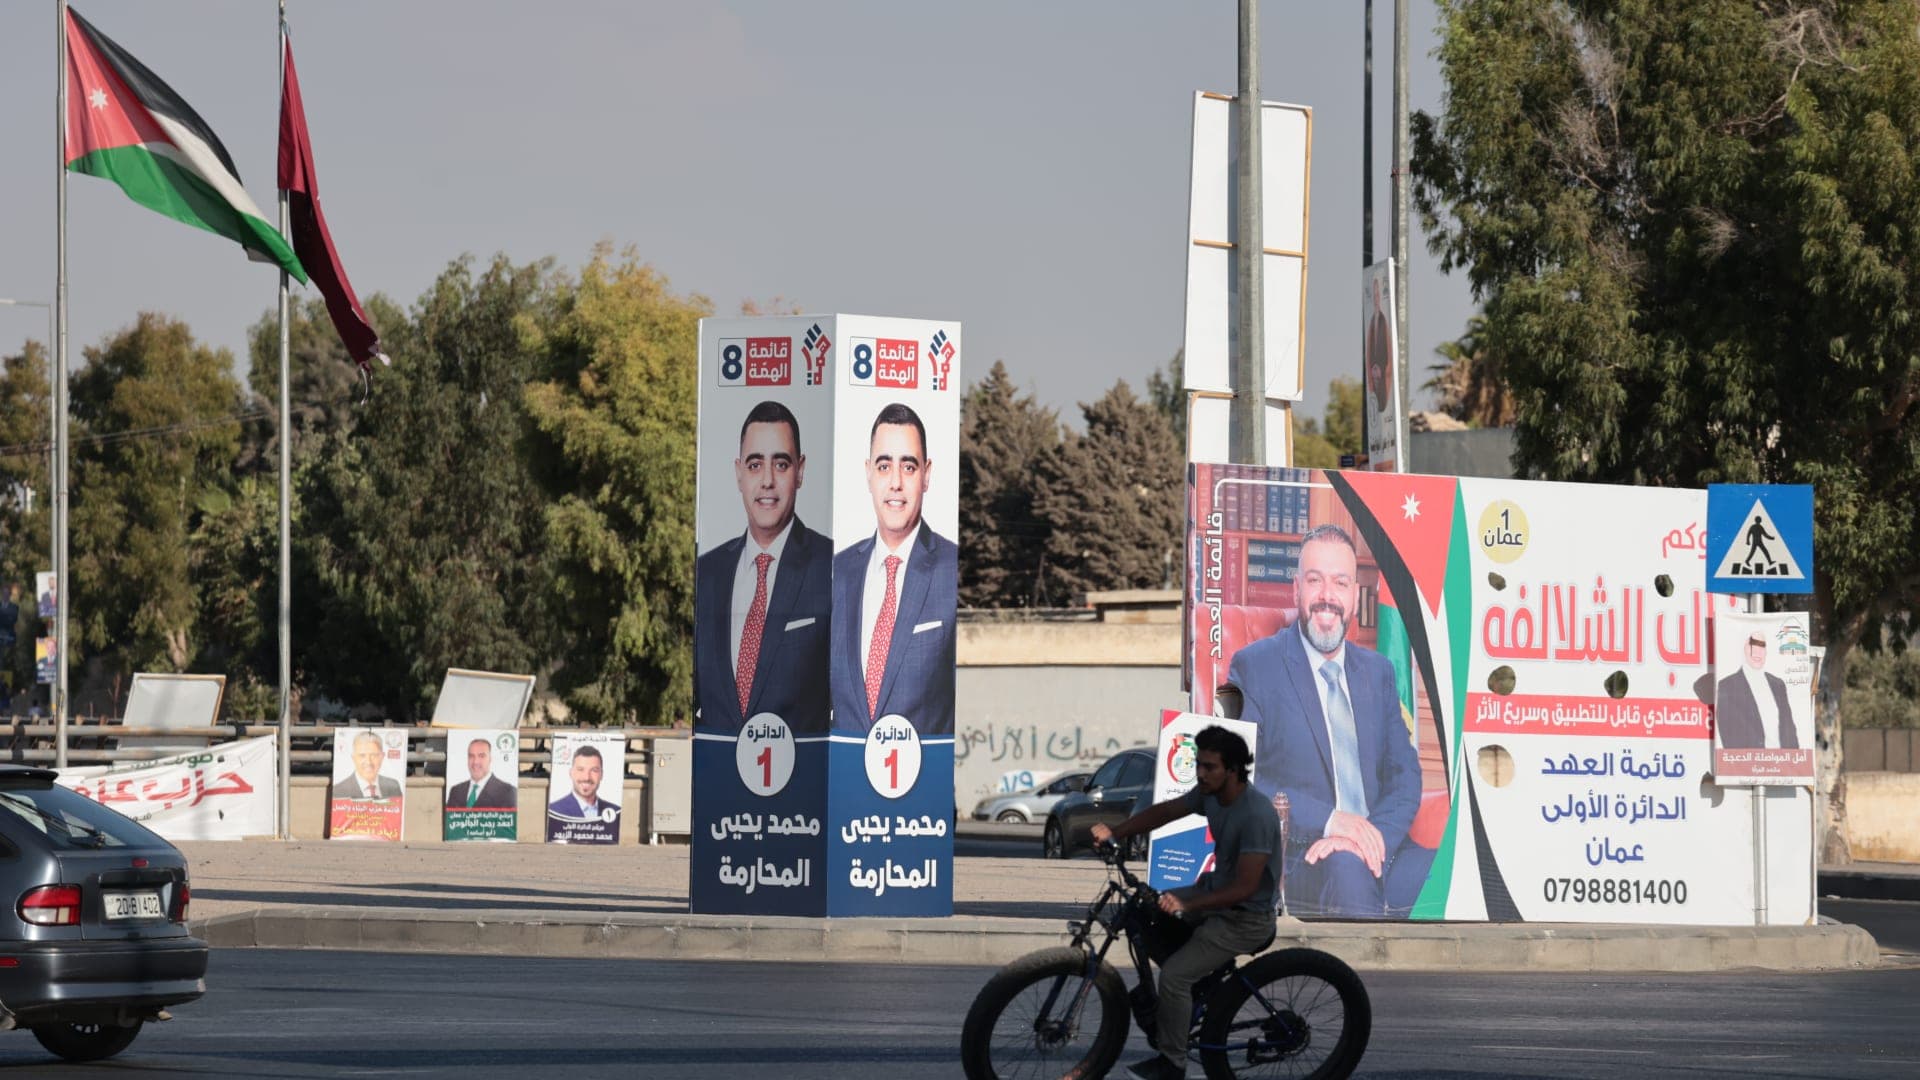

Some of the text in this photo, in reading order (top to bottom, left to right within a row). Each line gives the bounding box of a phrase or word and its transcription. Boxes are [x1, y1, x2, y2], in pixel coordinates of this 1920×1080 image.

[722, 344, 743, 380] 8
[749, 343, 788, 360] قائمة
[853, 343, 873, 380] 8
[878, 343, 915, 361] قائمة
[1500, 508, 1510, 531] 1
[1484, 528, 1524, 547] عمان
[1205, 511, 1223, 659] قائمة العهد
[1475, 696, 1501, 723] الأثر
[1503, 701, 1549, 725] وسريع
[1552, 702, 1608, 727] للتطبيق
[1610, 704, 1640, 728] قابل
[1643, 705, 1702, 734] اقتصادي
[747, 724, 786, 743] الدائرة
[875, 725, 912, 745] الدائرة
[756, 746, 772, 788] 1
[884, 748, 899, 789] 1
[1541, 749, 1686, 779] قائمة العهد
[1541, 789, 1687, 824] الدائرة الأولى
[710, 812, 821, 841] محمد يحيى
[841, 814, 947, 844] محمد يحيى
[1585, 837, 1645, 866] عمان
[718, 855, 810, 894] المحارمة
[849, 858, 937, 897] المحارمة
[1543, 877, 1688, 905] 0798881400
